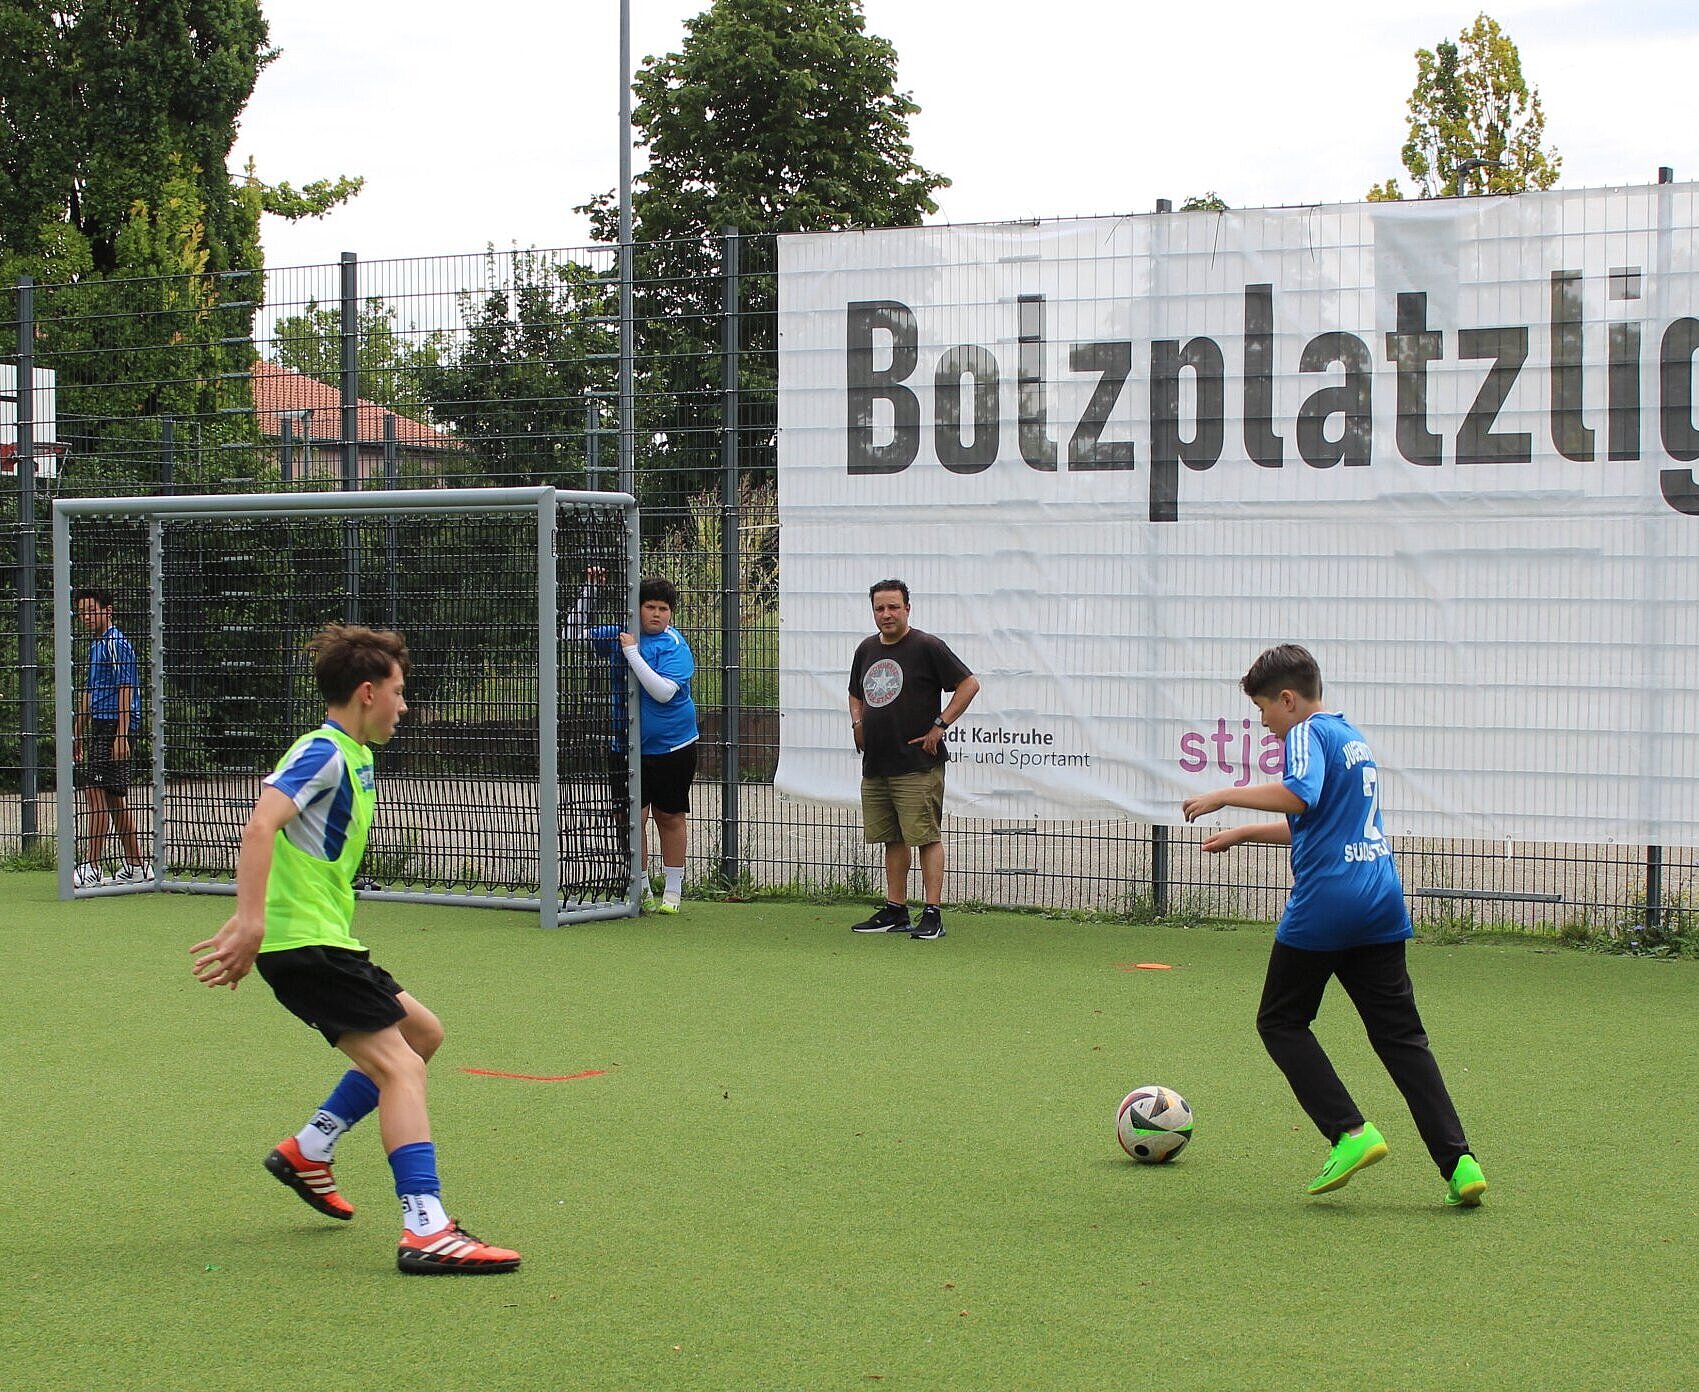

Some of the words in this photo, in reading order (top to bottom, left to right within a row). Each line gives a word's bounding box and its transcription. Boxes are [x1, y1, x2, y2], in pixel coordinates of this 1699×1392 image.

[972, 727, 1054, 745] Karlsruhe
[975, 747, 1004, 765] und
[1009, 749, 1091, 770] Sportamt
[1179, 717, 1286, 787] stja
[1362, 766, 1383, 841] 2
